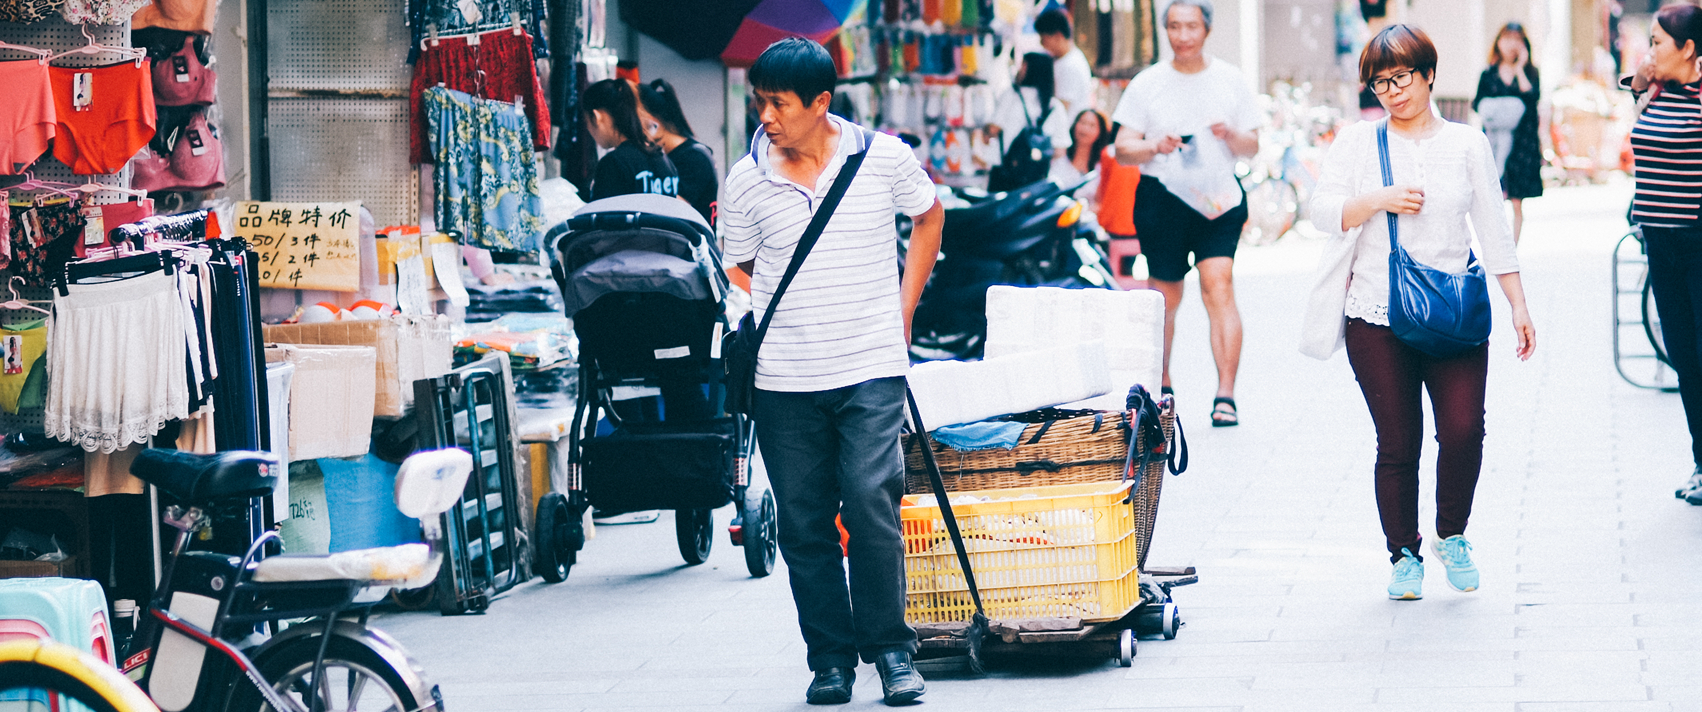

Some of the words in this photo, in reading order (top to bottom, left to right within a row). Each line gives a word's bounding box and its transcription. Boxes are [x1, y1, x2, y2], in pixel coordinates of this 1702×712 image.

[635, 170, 680, 195] Tiger
[239, 204, 352, 230] 品牌特价
